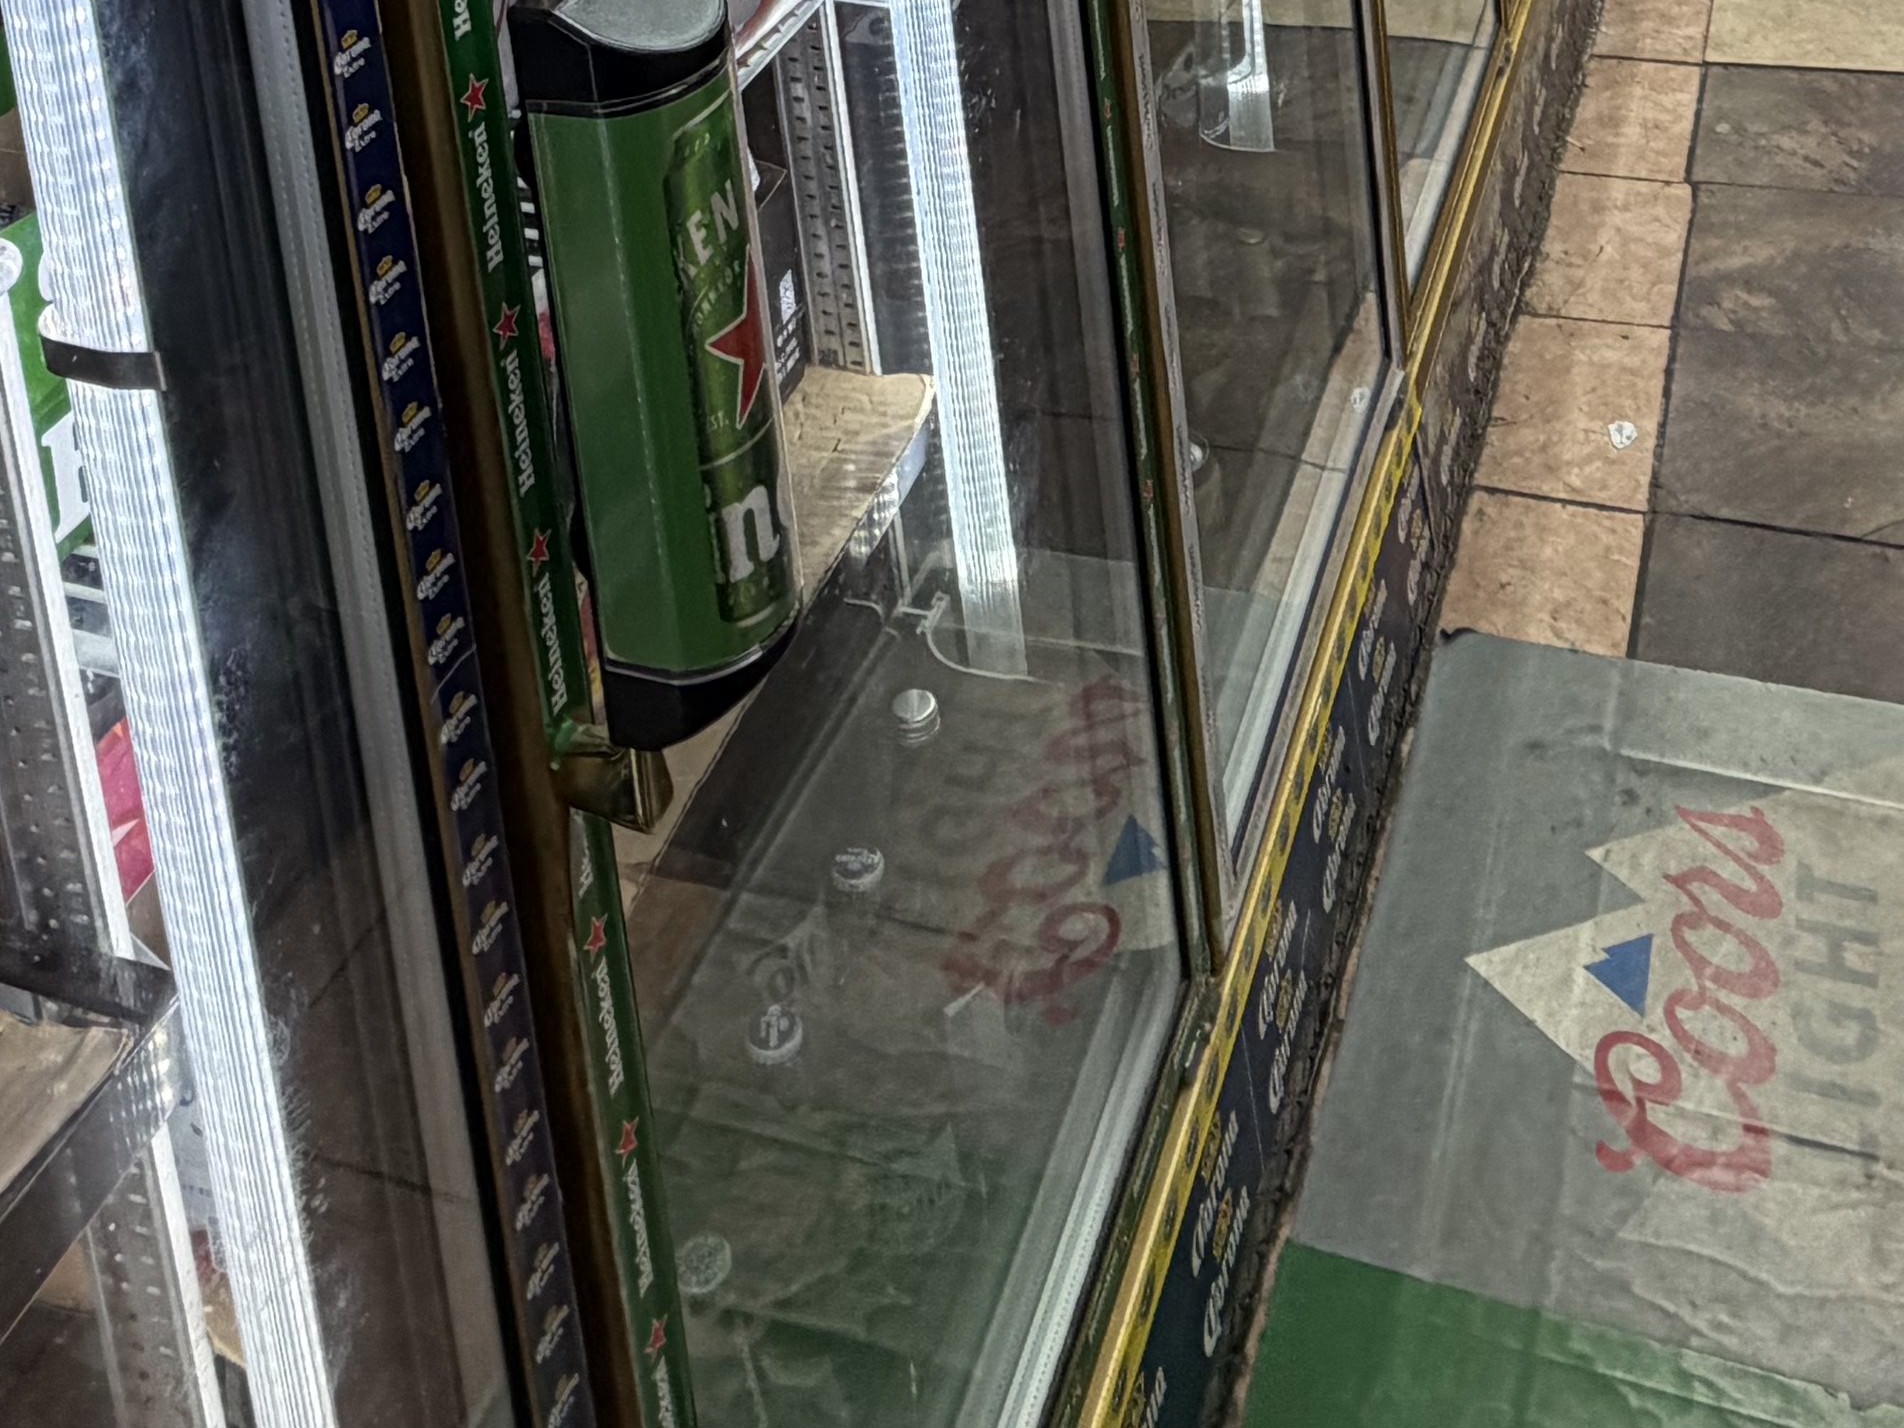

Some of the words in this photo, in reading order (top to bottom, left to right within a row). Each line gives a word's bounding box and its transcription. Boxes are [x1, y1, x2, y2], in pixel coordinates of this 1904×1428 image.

[498, 356, 537, 497] Heineken
[1594, 805, 1785, 1195] Coors
[1789, 859, 1883, 1109] IGHT
